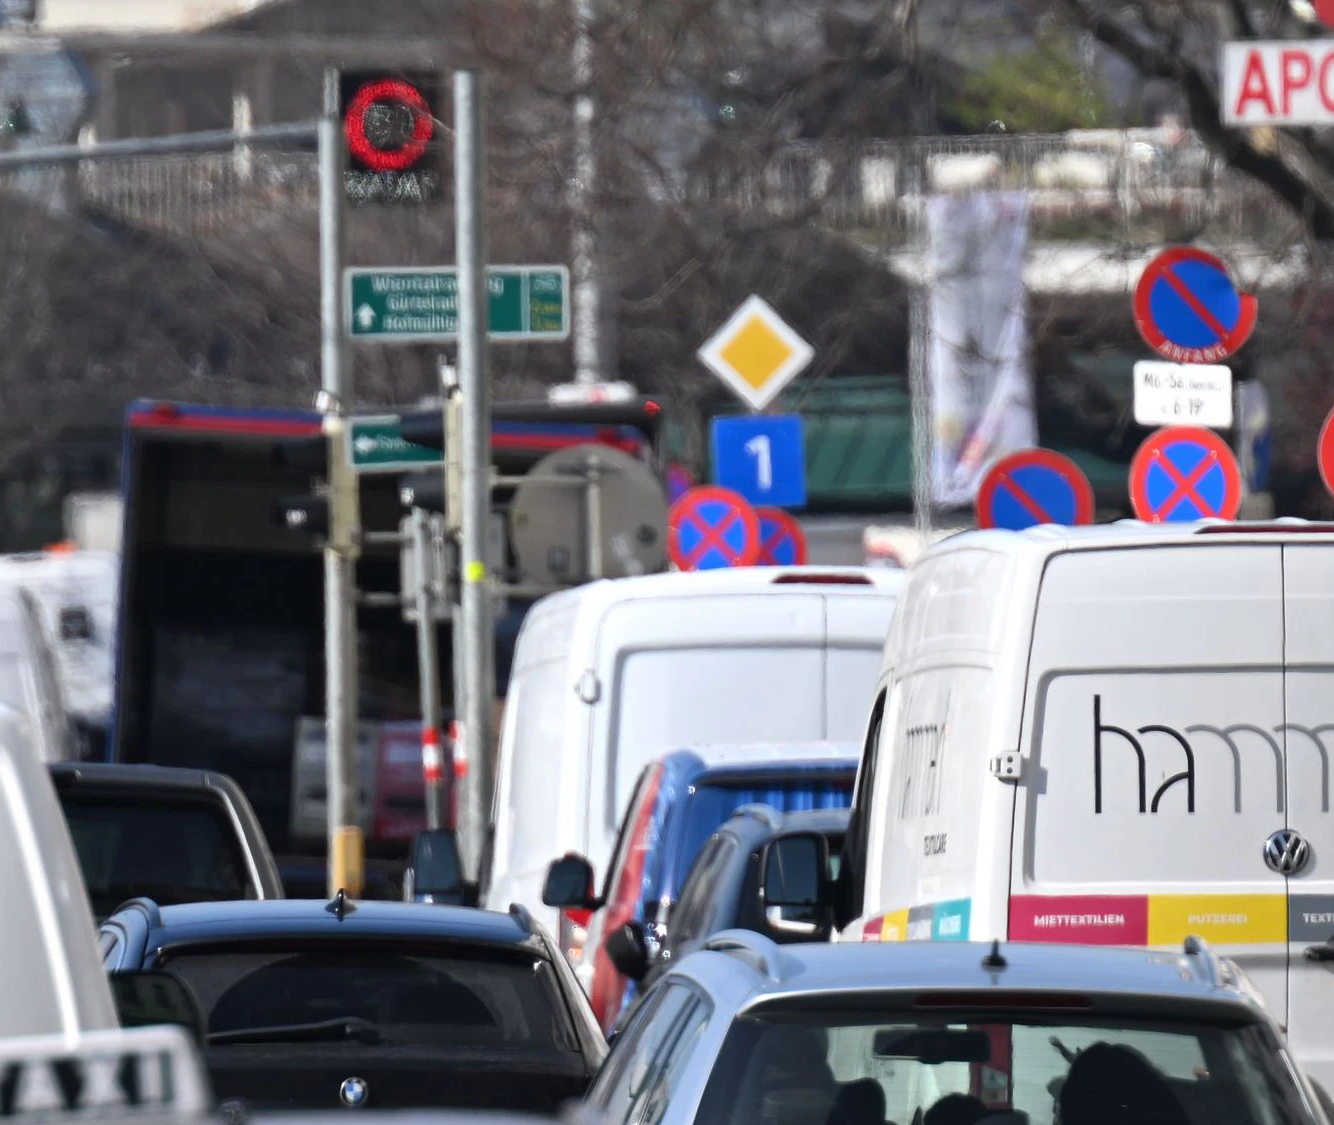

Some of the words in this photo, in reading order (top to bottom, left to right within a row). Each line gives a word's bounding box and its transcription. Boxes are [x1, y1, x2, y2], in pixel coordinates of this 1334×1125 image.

[1158, 340, 1228, 362] ANFANG
[744, 435, 773, 491] 1
[1034, 913, 1126, 928] MIETTEXTILIEN
[1188, 913, 1248, 925] PUTZEREI
